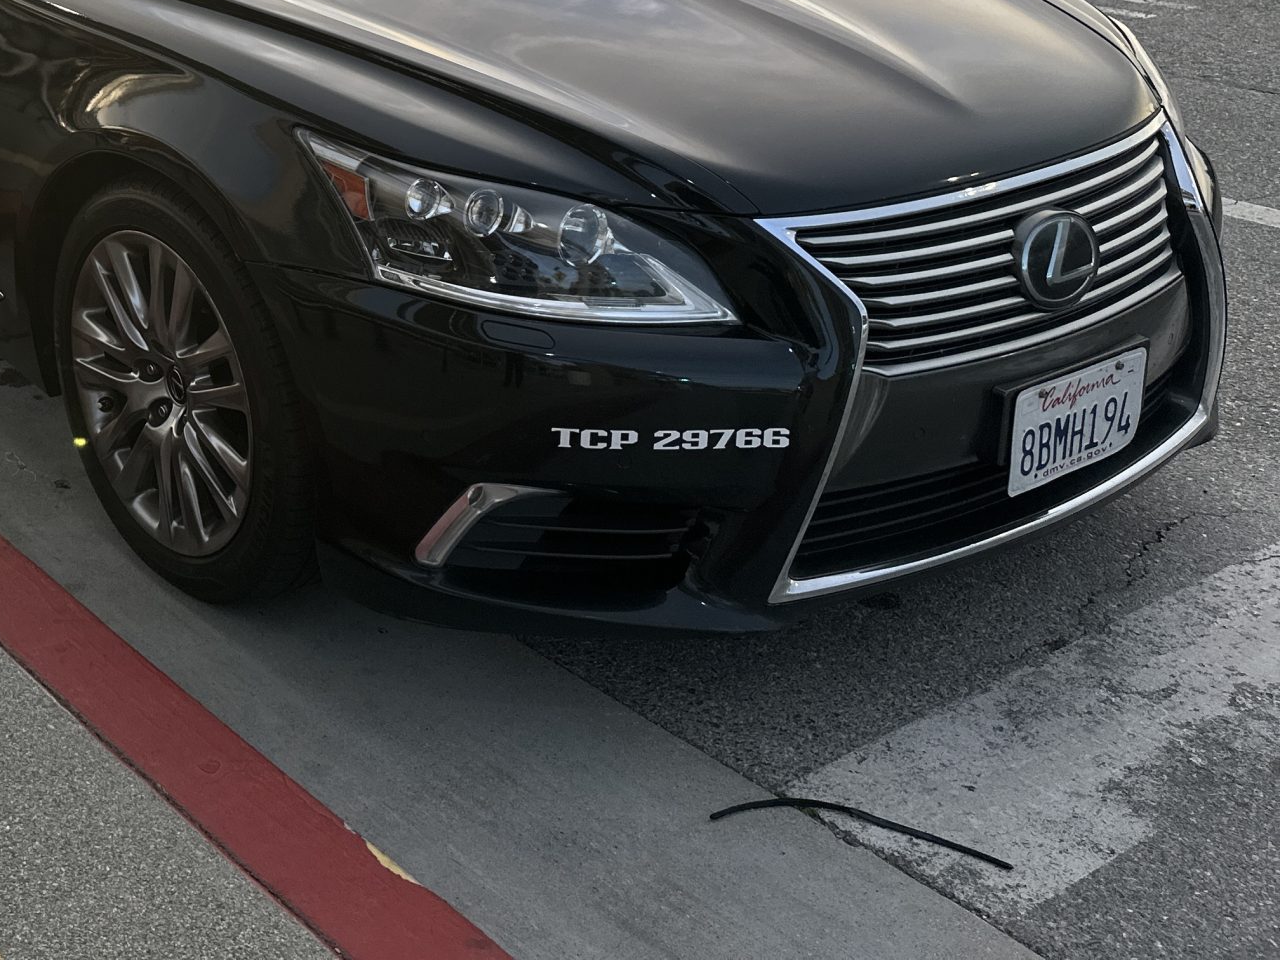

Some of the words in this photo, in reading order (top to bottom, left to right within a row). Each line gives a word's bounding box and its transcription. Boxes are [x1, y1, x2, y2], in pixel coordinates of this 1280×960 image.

[1041, 373, 1121, 412] California
[551, 427, 638, 450] TCP
[653, 427, 790, 450] 29766
[1020, 391, 1131, 476] 8BMH194
[1042, 444, 1108, 478] dmv.ca.gov
